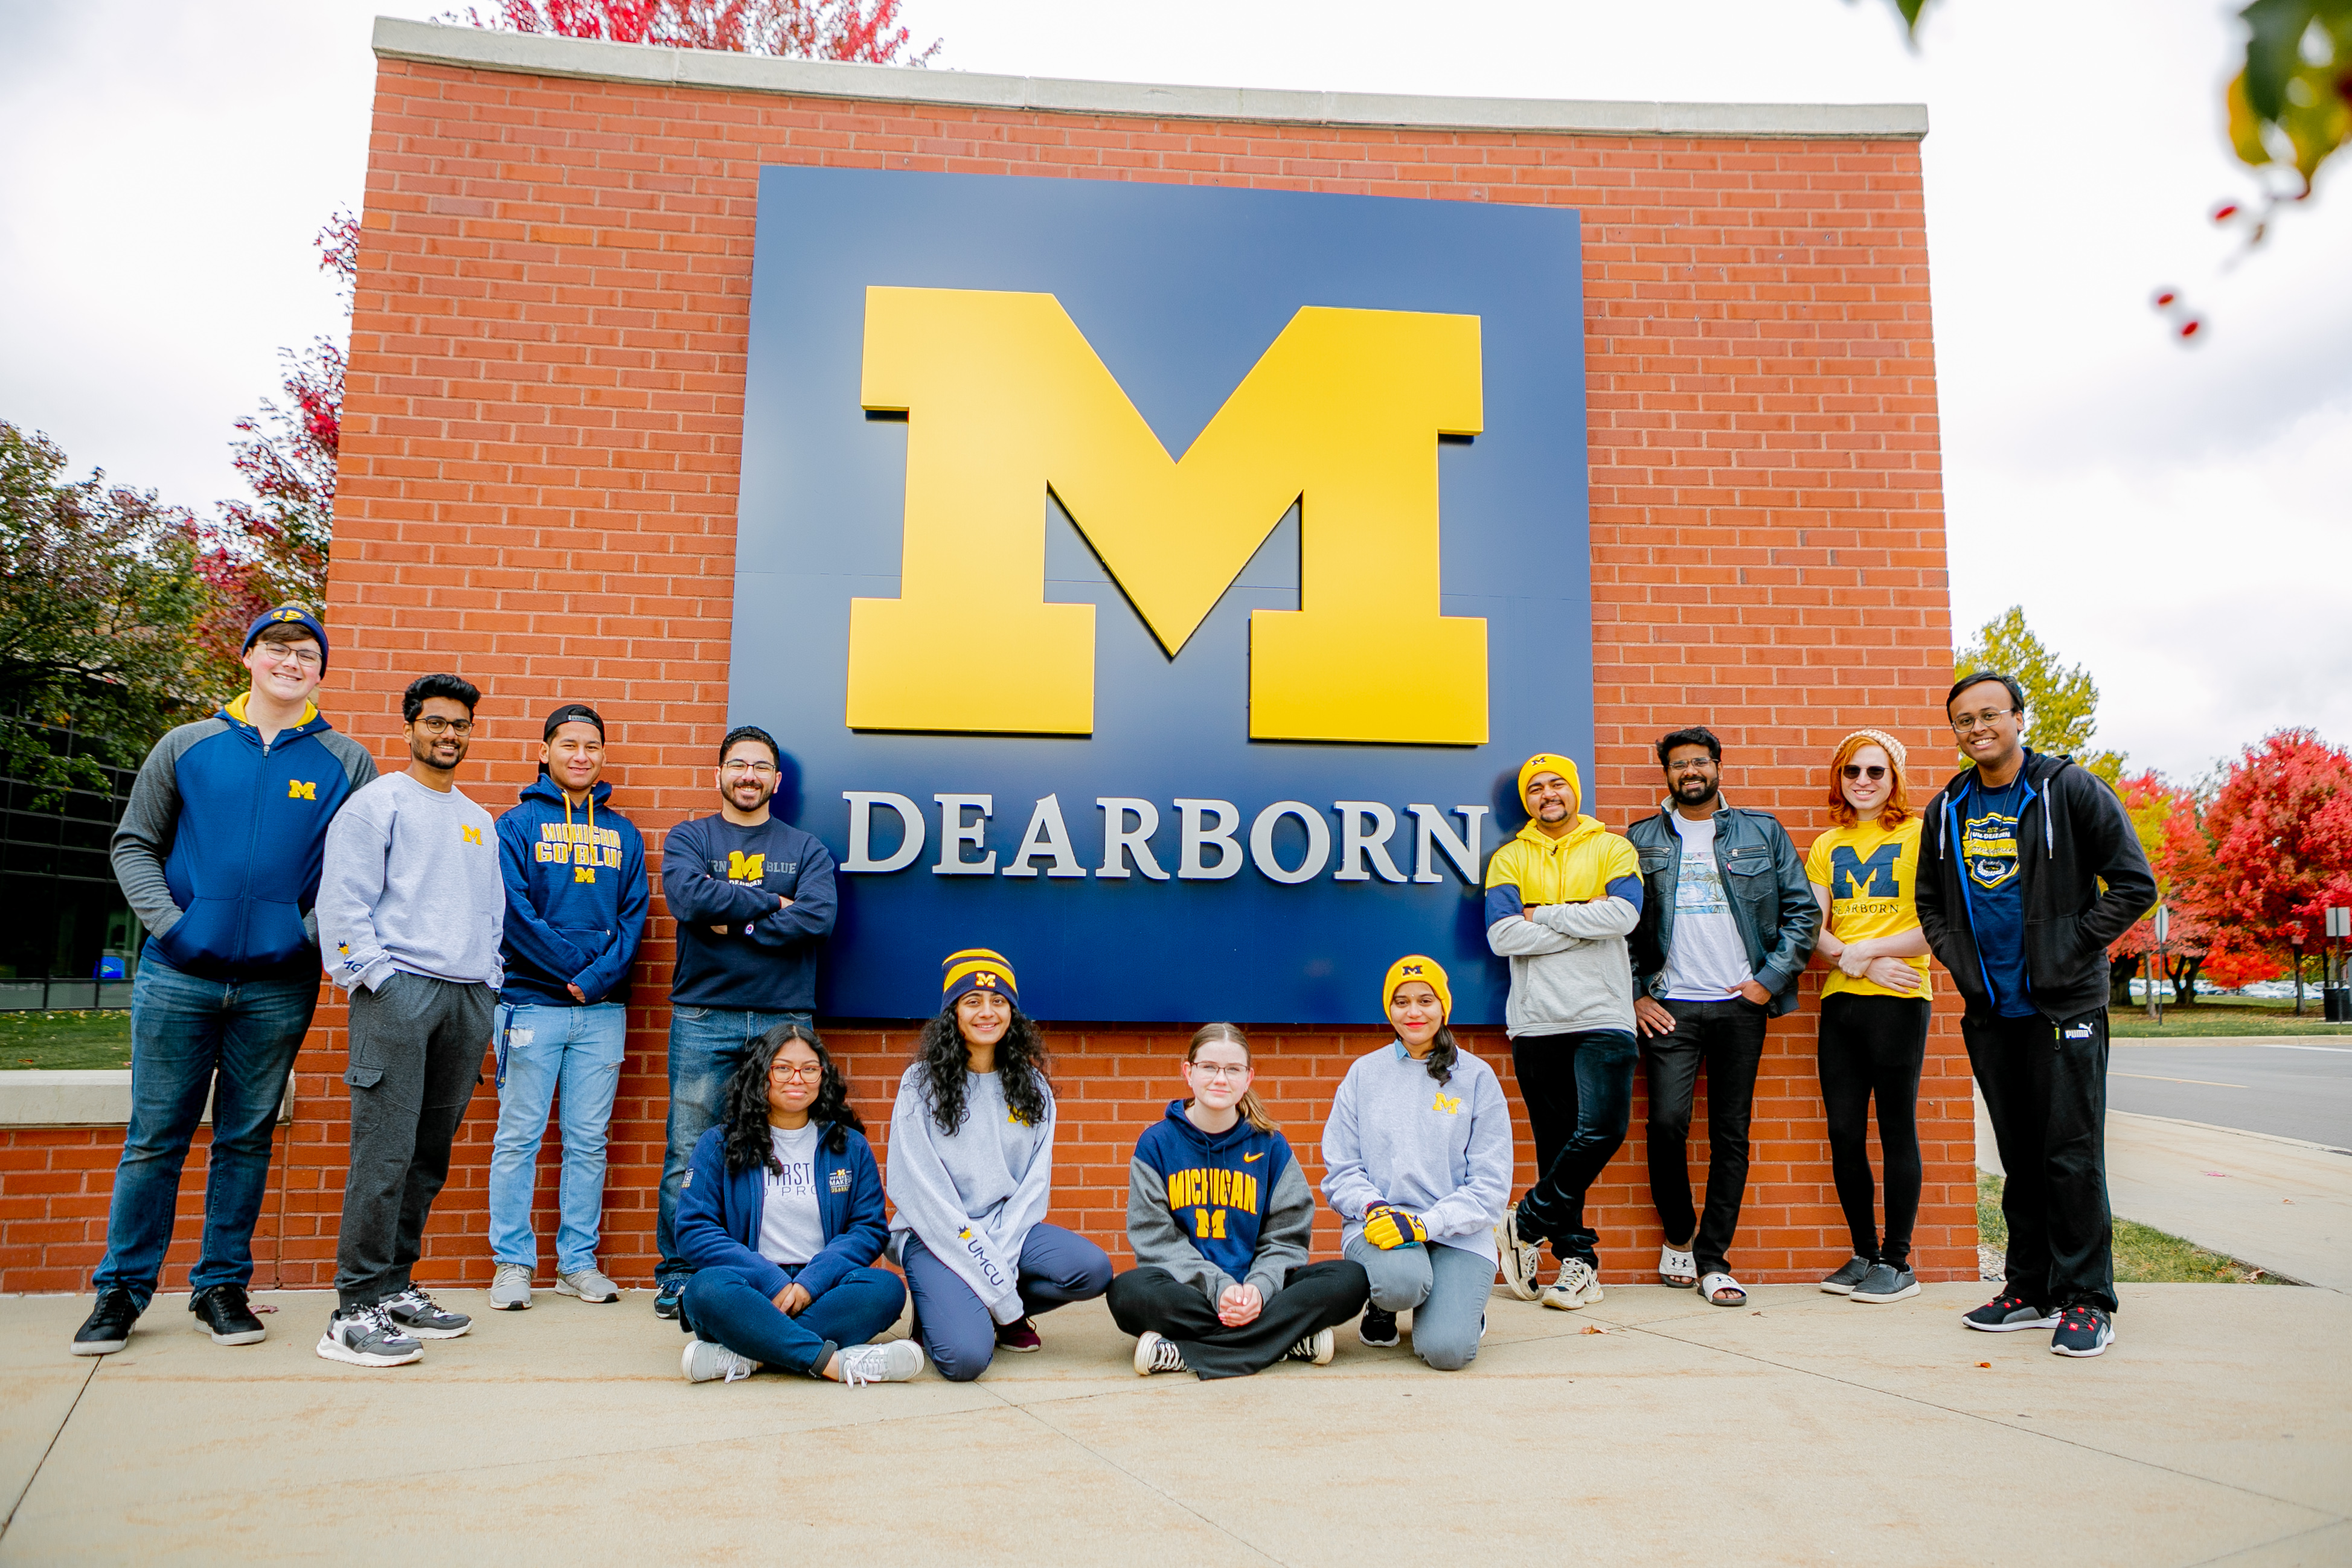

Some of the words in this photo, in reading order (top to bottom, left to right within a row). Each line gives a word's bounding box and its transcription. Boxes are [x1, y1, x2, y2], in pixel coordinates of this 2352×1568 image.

[847, 286, 1488, 744] M
[288, 779, 316, 801] M
[461, 824, 483, 846] M
[839, 791, 1489, 885] DEARBORN
[534, 841, 569, 864] GO
[574, 866, 595, 884] M
[728, 850, 765, 881] M
[766, 860, 797, 874] BLUE
[1830, 842, 1903, 900] M
[1832, 904, 1899, 915] DEARBORN
[975, 972, 996, 988] M
[1402, 965, 1423, 976] M
[2065, 1029, 2089, 1038] PUMA
[1432, 1092, 1462, 1115] M
[1168, 1168, 1257, 1215] MICHIGAN
[1195, 1208, 1226, 1239] M
[968, 1239, 1004, 1286] UMCU
